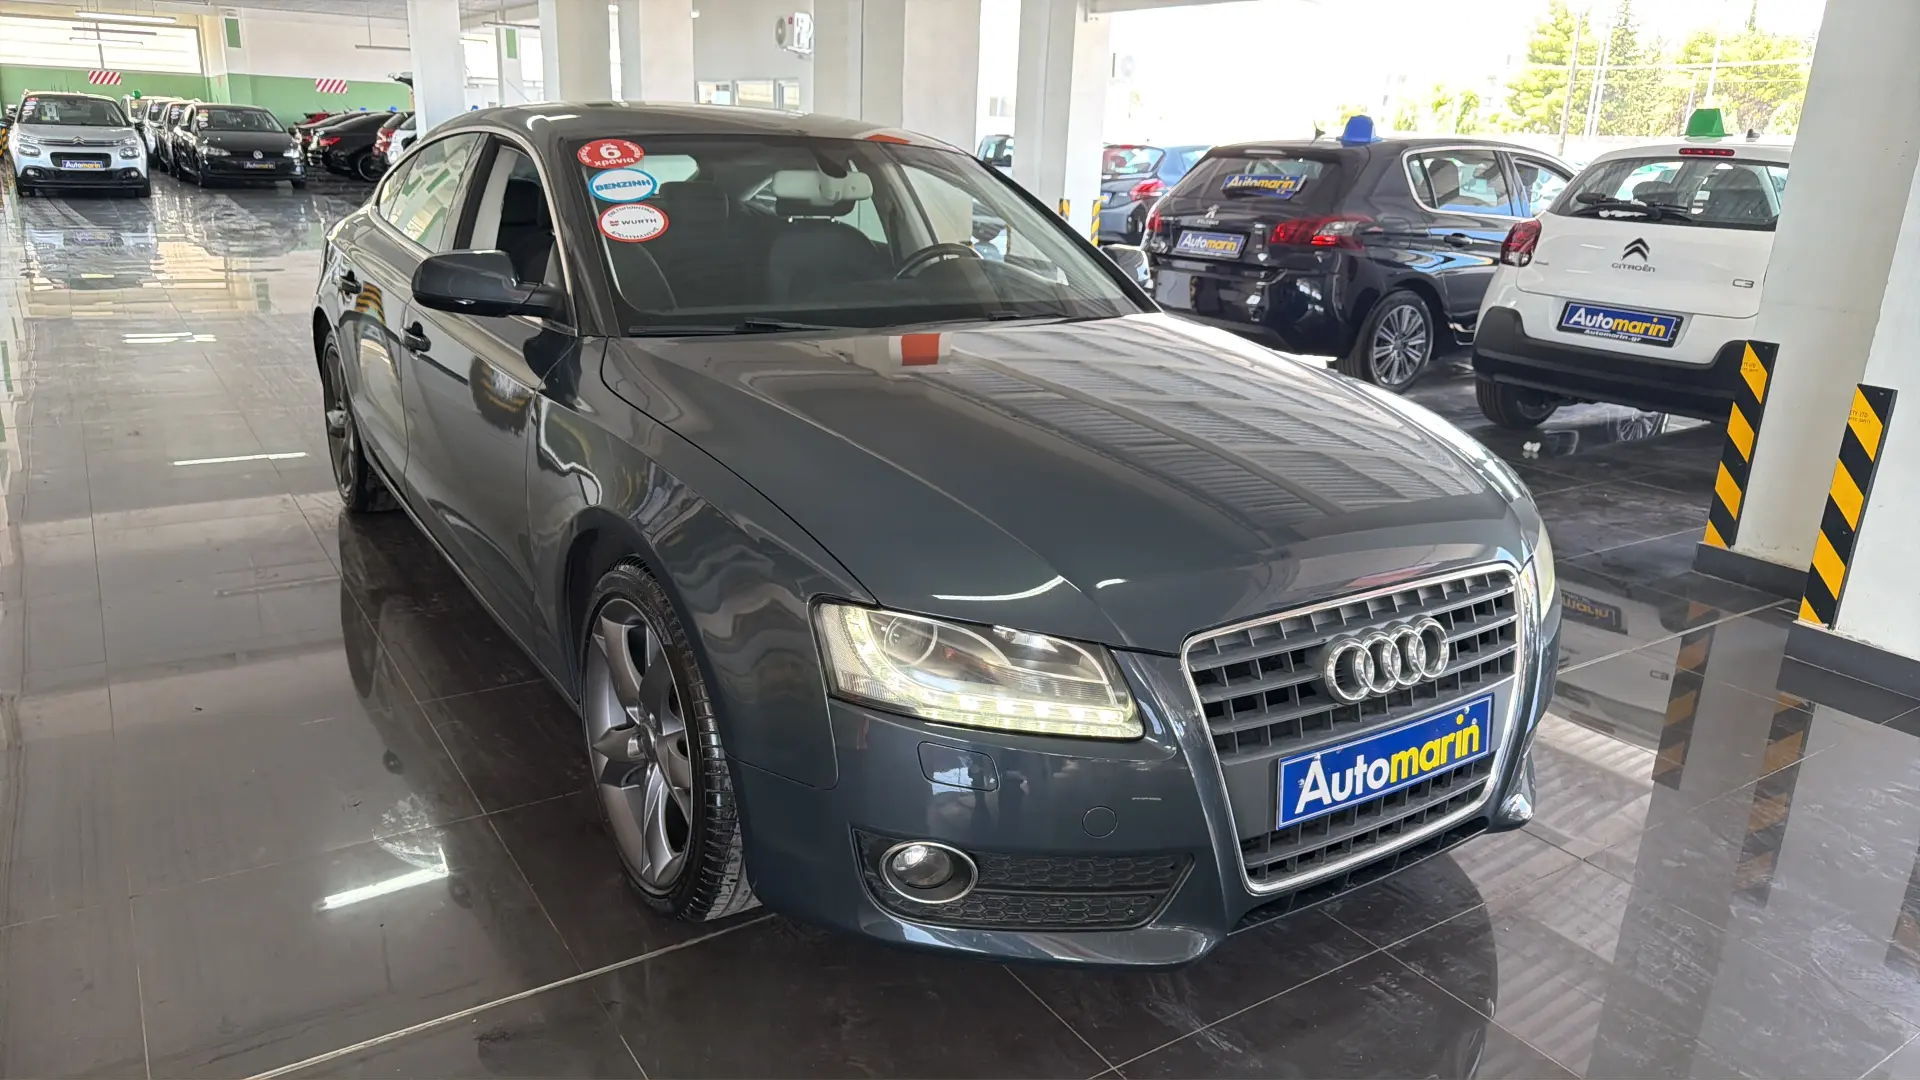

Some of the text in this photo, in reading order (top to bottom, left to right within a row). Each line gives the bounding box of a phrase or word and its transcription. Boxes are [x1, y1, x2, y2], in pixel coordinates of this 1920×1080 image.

[600, 144, 622, 159] 6
[65, 160, 101, 168] Automarin
[1227, 175, 1296, 190] Automarin
[1180, 232, 1237, 252] Automarin
[1732, 278, 1755, 289] C3
[1568, 307, 1666, 337] Automarin
[1584, 329, 1642, 342] Automarin.gr
[1294, 713, 1481, 814] Automarin
